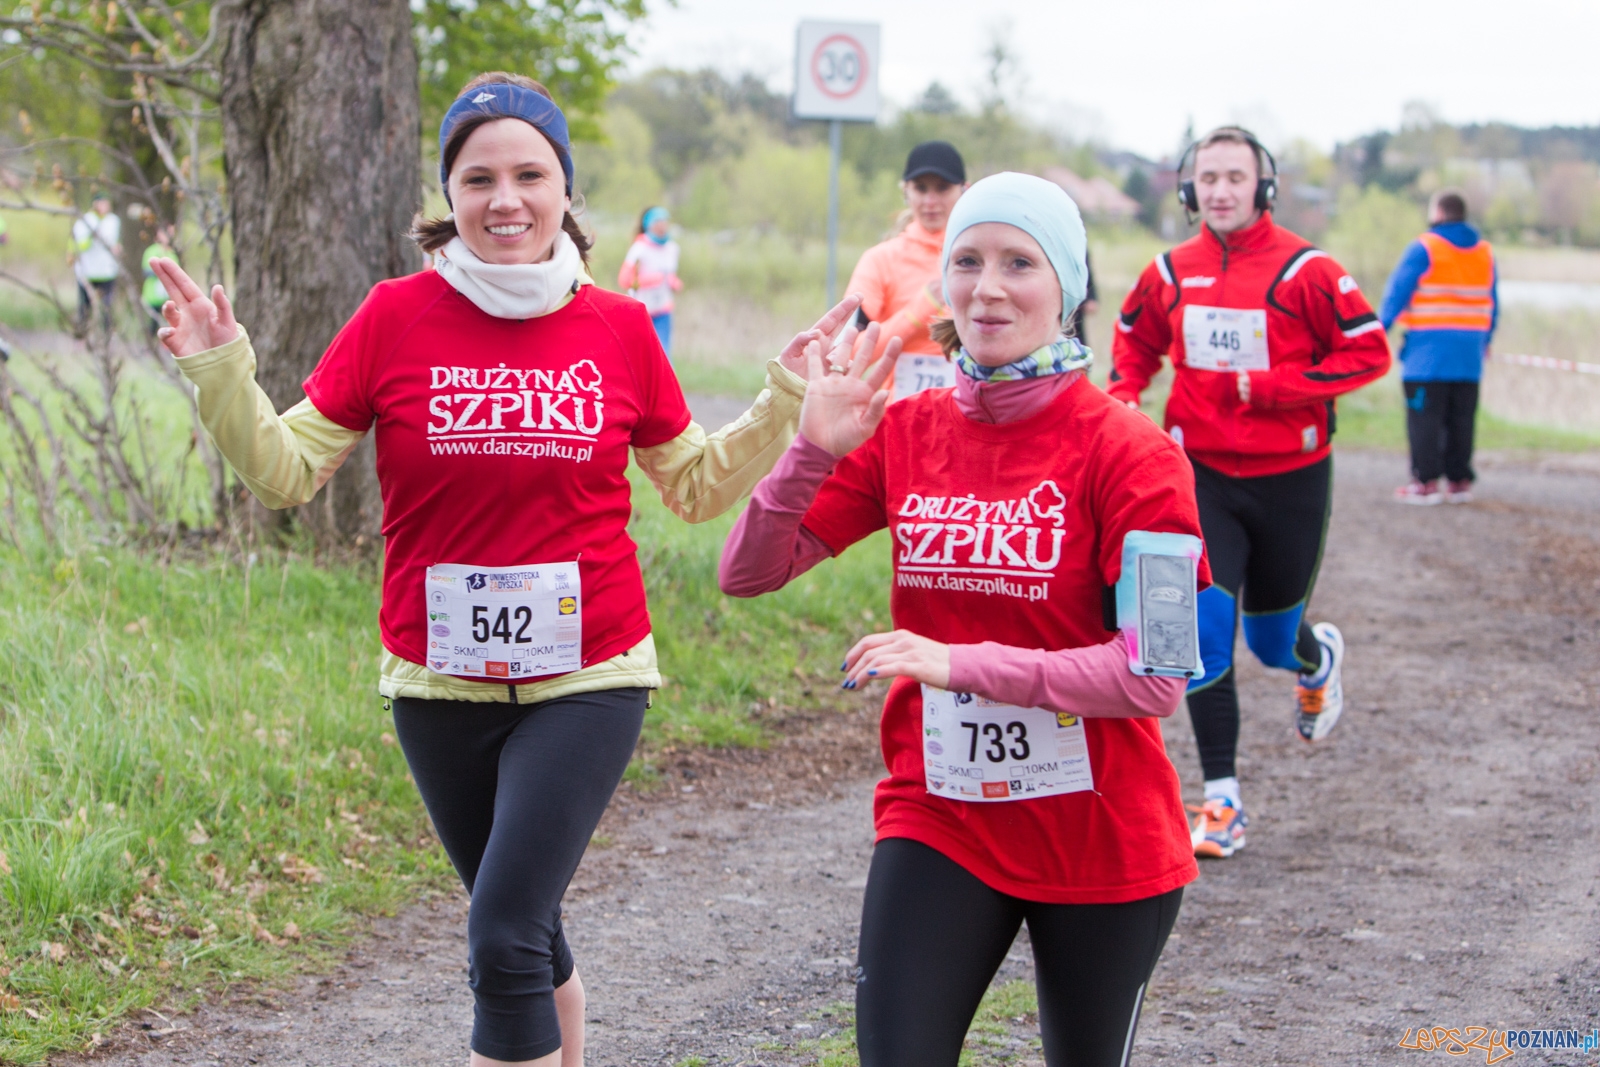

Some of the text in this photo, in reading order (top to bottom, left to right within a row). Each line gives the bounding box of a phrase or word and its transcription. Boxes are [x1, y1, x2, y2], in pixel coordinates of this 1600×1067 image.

[820, 50, 859, 81] 30
[1209, 330, 1241, 351] 446
[429, 363, 578, 393] DRUŻYNA
[427, 390, 604, 435] SZPIKU
[429, 438, 593, 463] www.darszpiku.pl
[898, 493, 1033, 524] DRUŻYNA
[896, 522, 1067, 571] SZPIKU
[489, 571, 540, 581] UNIWERSYTECKA
[524, 580, 533, 592] IV
[897, 572, 1049, 602] www.darszpiku.pl
[472, 605, 533, 644] 542
[454, 645, 476, 657] 5KM
[525, 645, 554, 657] 10KM
[960, 721, 1031, 763] 733
[948, 765, 971, 778] 5KM
[1025, 761, 1059, 775] 10KM
